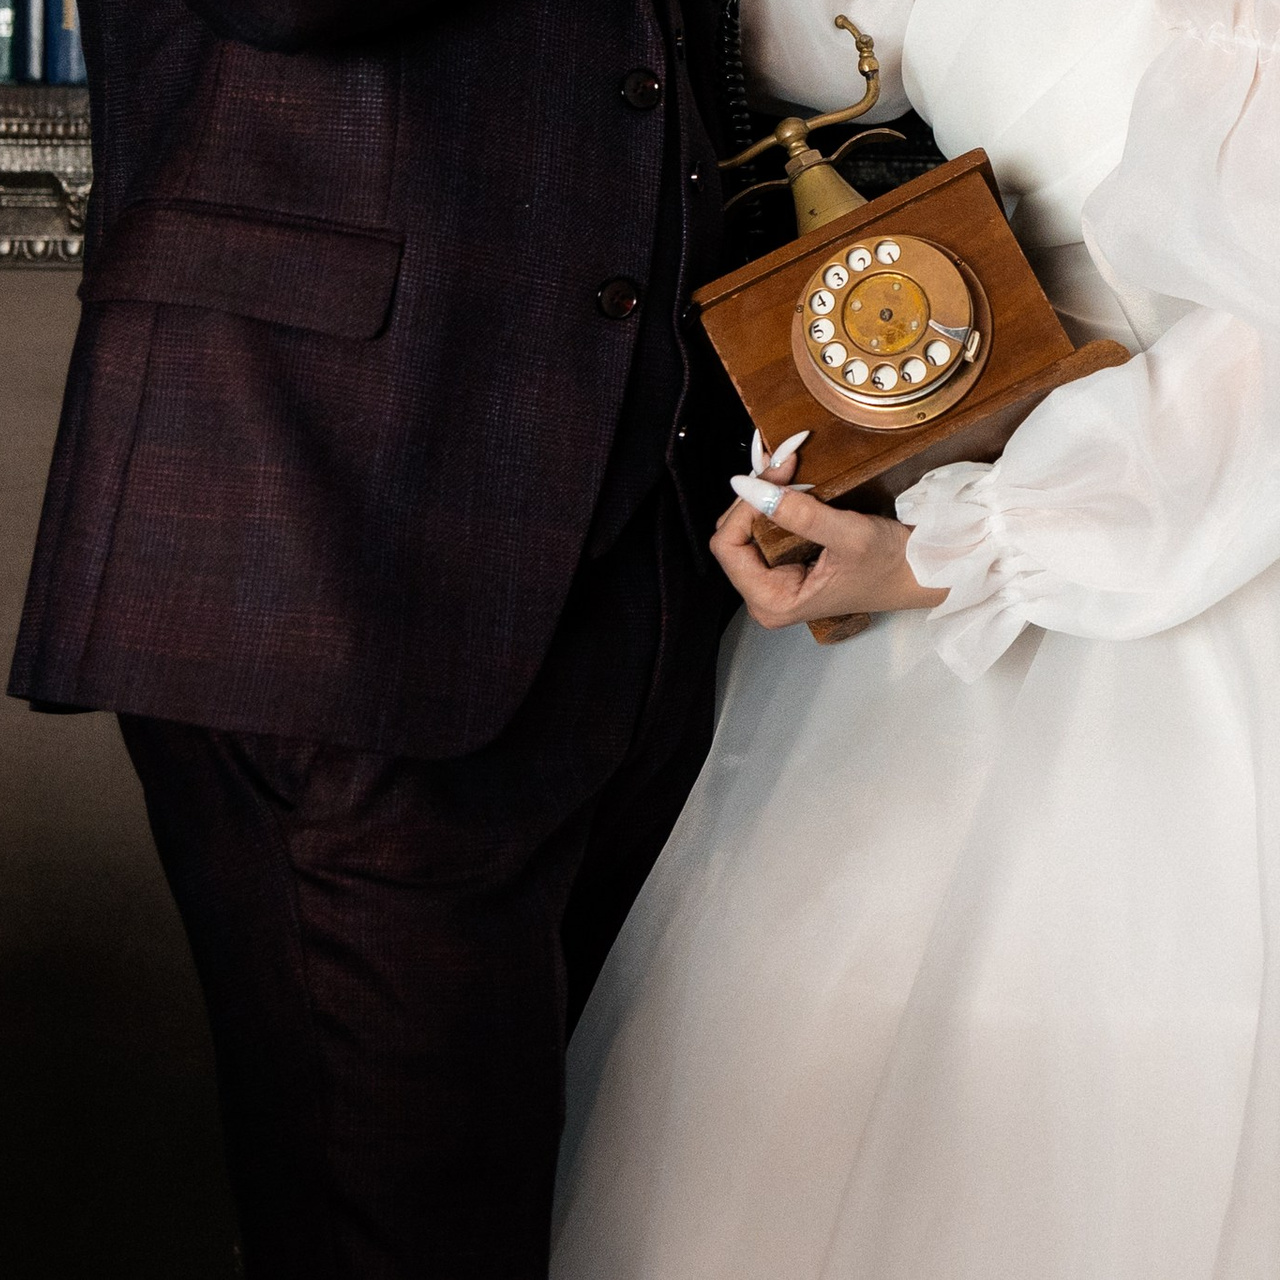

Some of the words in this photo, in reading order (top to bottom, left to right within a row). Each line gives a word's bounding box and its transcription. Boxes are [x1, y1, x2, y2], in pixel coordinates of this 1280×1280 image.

[832, 272, 845, 287] 3
[817, 294, 828, 308] 4
[813, 324, 825, 339] 5
[822, 350, 834, 365] 6
[844, 369, 856, 384] 7
